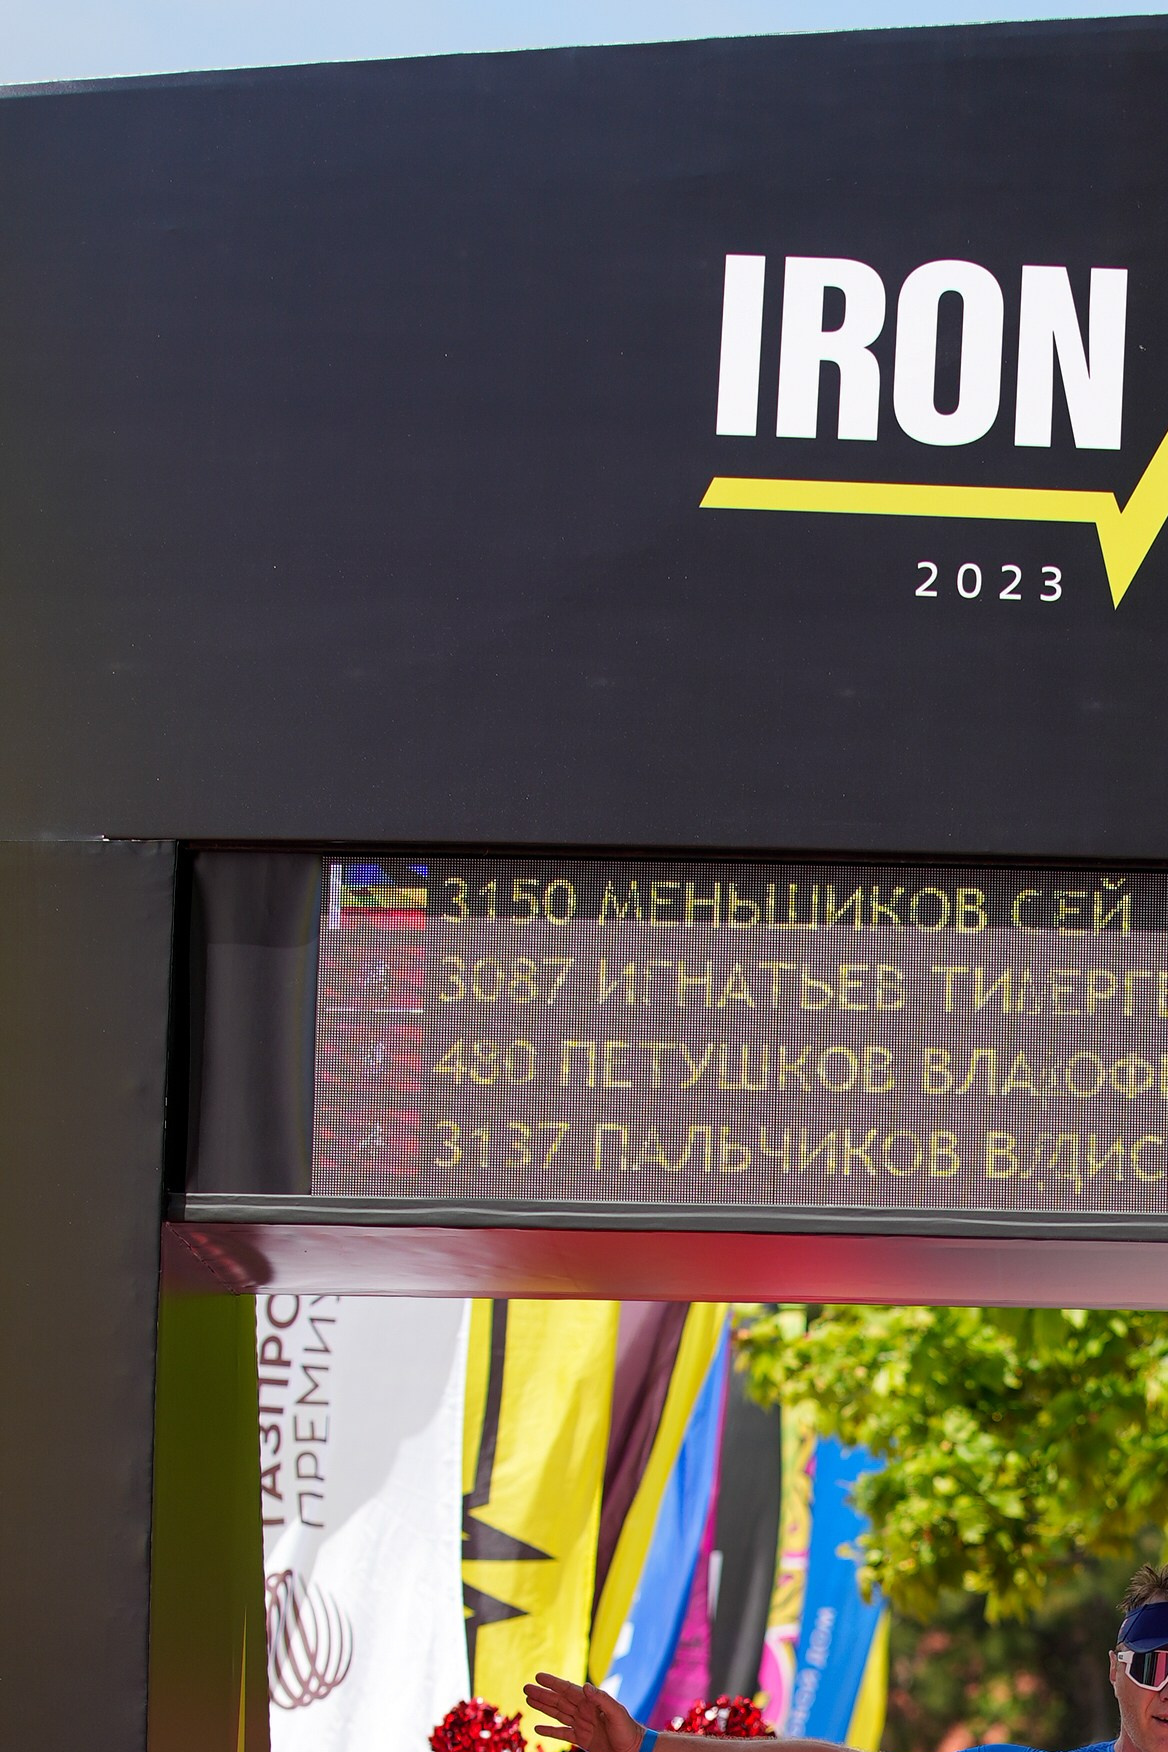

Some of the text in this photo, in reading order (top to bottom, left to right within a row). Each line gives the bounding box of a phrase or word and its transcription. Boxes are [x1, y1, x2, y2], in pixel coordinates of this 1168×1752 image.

[714, 252, 1129, 451] IRON
[914, 560, 1065, 603] 2023
[441, 878, 577, 927] 3150
[437, 956, 574, 1005] 3087
[599, 958, 904, 1012] ИГНАТЬЕВ
[433, 1039, 536, 1087] 480
[559, 1040, 896, 1093] ПЕТУШКОВ
[434, 1120, 571, 1171] 3137
[594, 1122, 961, 1178] ПАЛЬЧИКОВ
